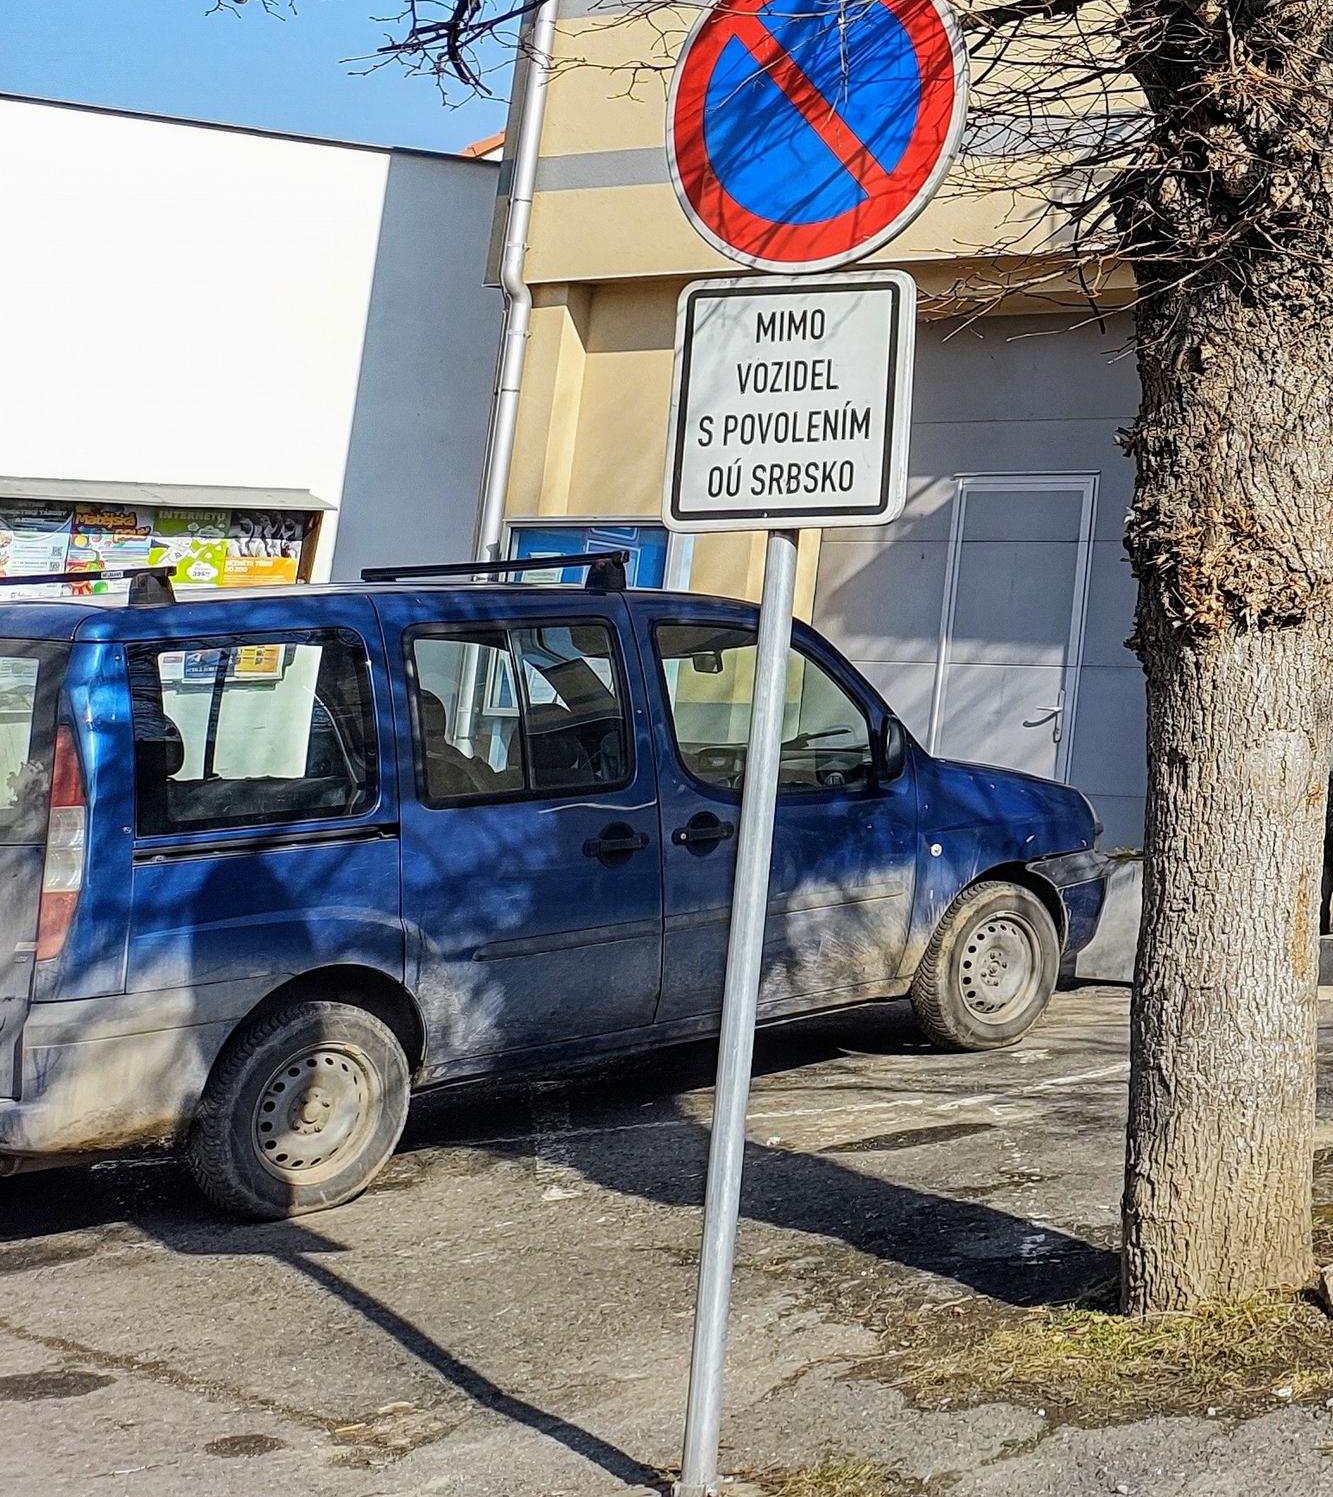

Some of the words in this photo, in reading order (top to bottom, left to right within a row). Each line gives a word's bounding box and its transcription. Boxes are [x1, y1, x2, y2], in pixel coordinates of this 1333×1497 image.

[755, 308, 825, 343] MIMO
[737, 358, 839, 395] VOZIDEL
[697, 414, 714, 448] S
[722, 400, 872, 447] POVOLENÍM
[707, 457, 742, 499] OÚ
[750, 459, 855, 496] SRBSKO
